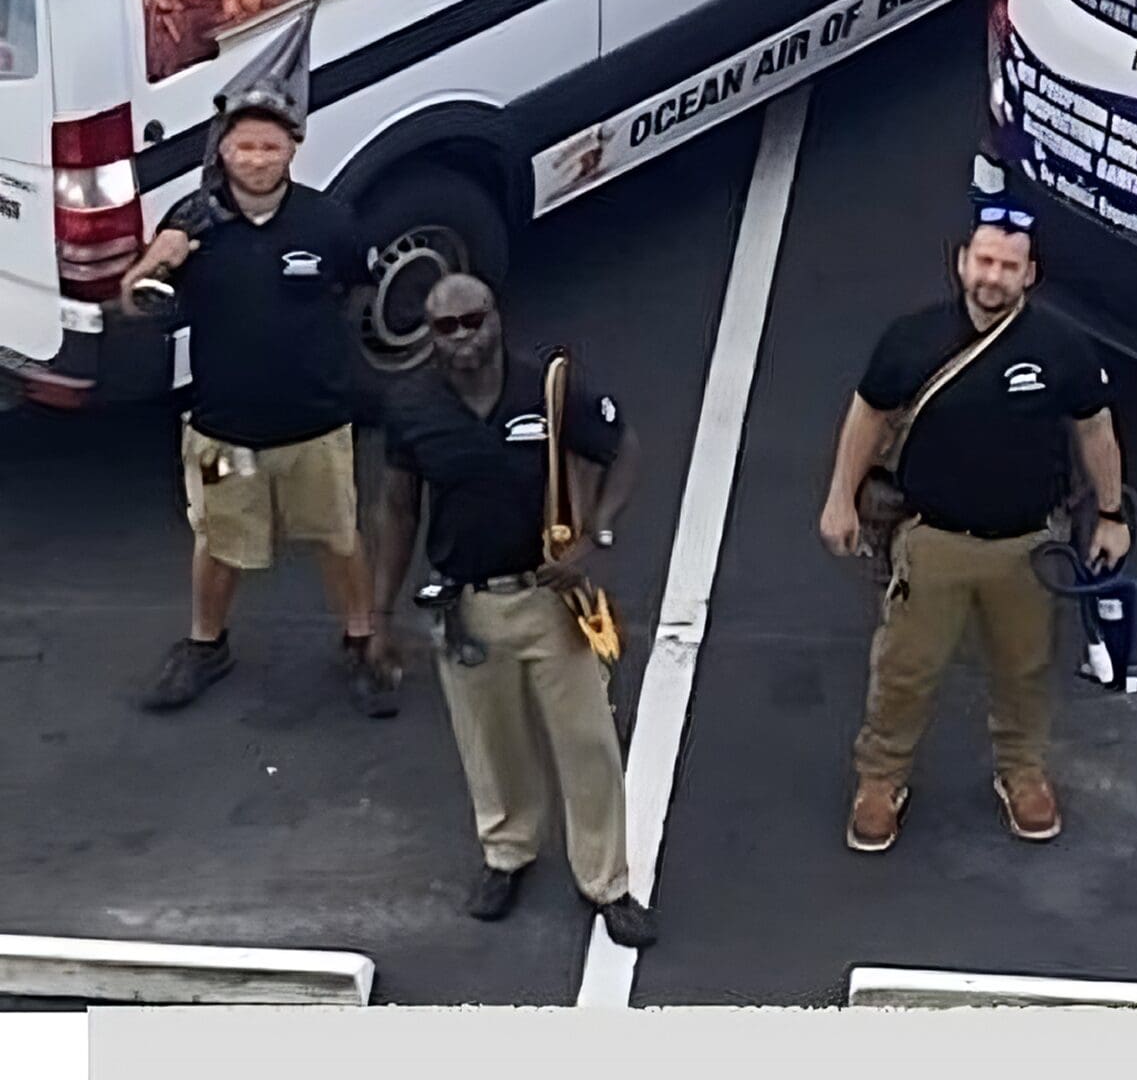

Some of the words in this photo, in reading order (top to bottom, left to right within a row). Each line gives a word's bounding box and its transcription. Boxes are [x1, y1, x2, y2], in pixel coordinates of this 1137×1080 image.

[630, 62, 747, 148] OCEAN
[752, 28, 811, 85] AIR
[819, 0, 864, 48] OF
